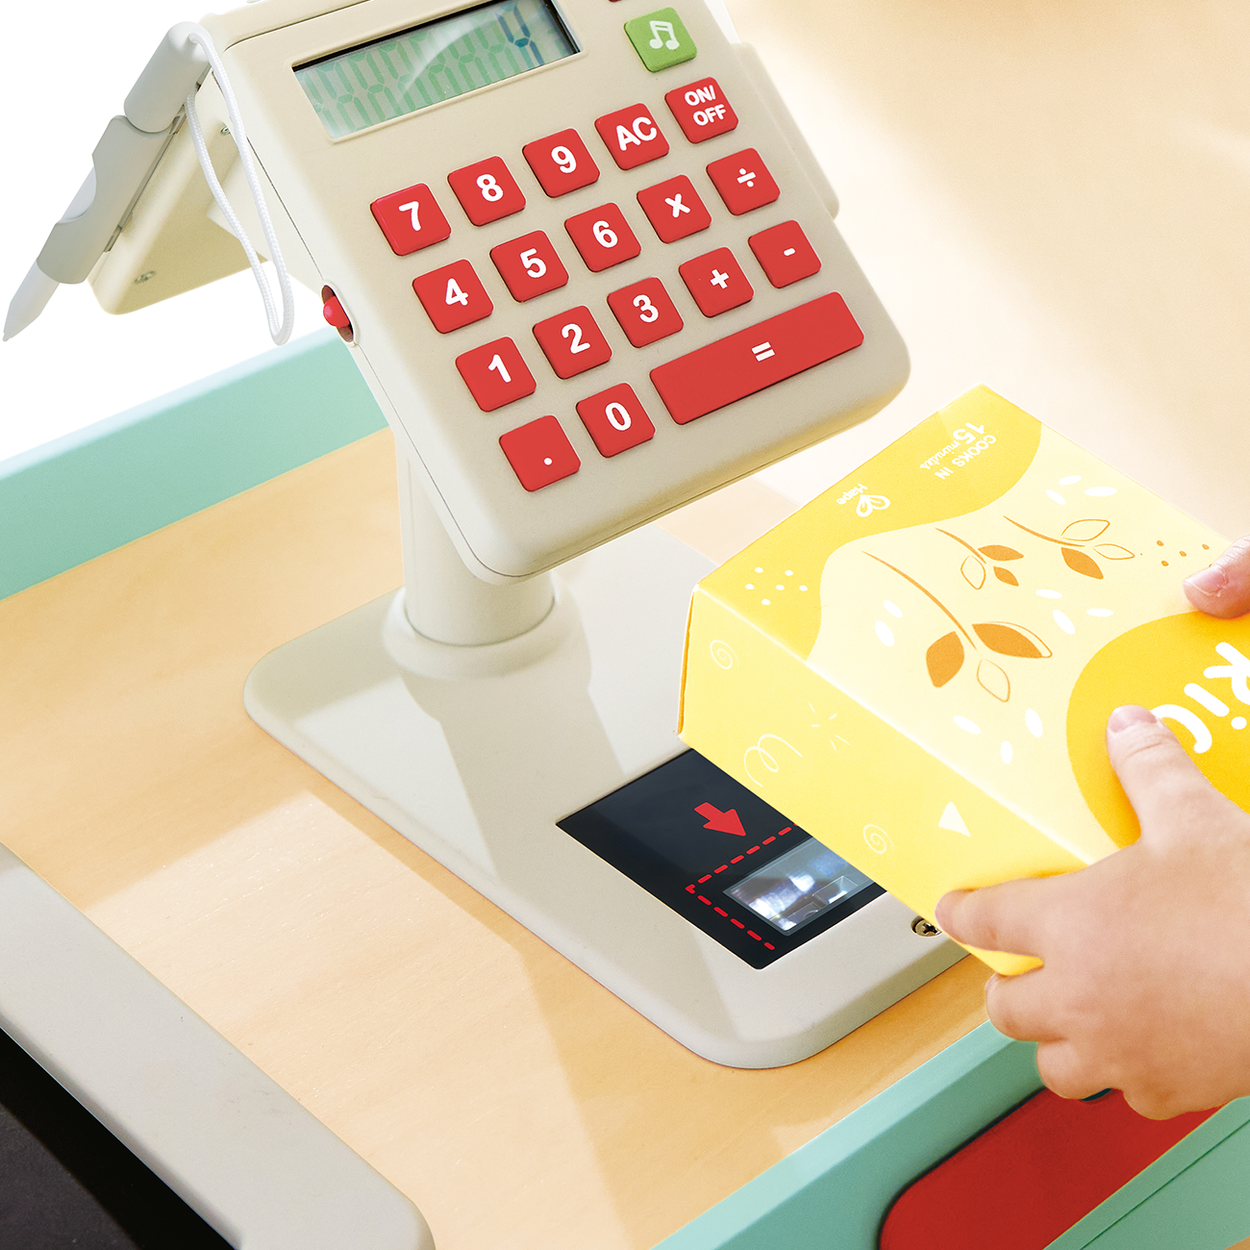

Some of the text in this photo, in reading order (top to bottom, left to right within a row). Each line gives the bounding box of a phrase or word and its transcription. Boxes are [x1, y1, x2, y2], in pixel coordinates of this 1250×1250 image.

[684, 84, 717, 107] ON/
[692, 103, 727, 126] OFF
[616, 116, 658, 151] AC
[551, 145, 577, 174] 9
[476, 173, 504, 202] 8
[398, 200, 422, 232] 7
[592, 220, 618, 248] 6
[519, 248, 547, 279] 5
[445, 278, 469, 306] 4
[710, 268, 730, 289] +
[632, 294, 659, 323] 3
[561, 323, 591, 354] 2
[751, 341, 776, 362] =
[487, 354, 512, 383] 1
[605, 402, 632, 431] 0
[919, 422, 985, 470] 15 minutes
[934, 434, 997, 480] COOKS IN
[835, 482, 869, 506] Hape
